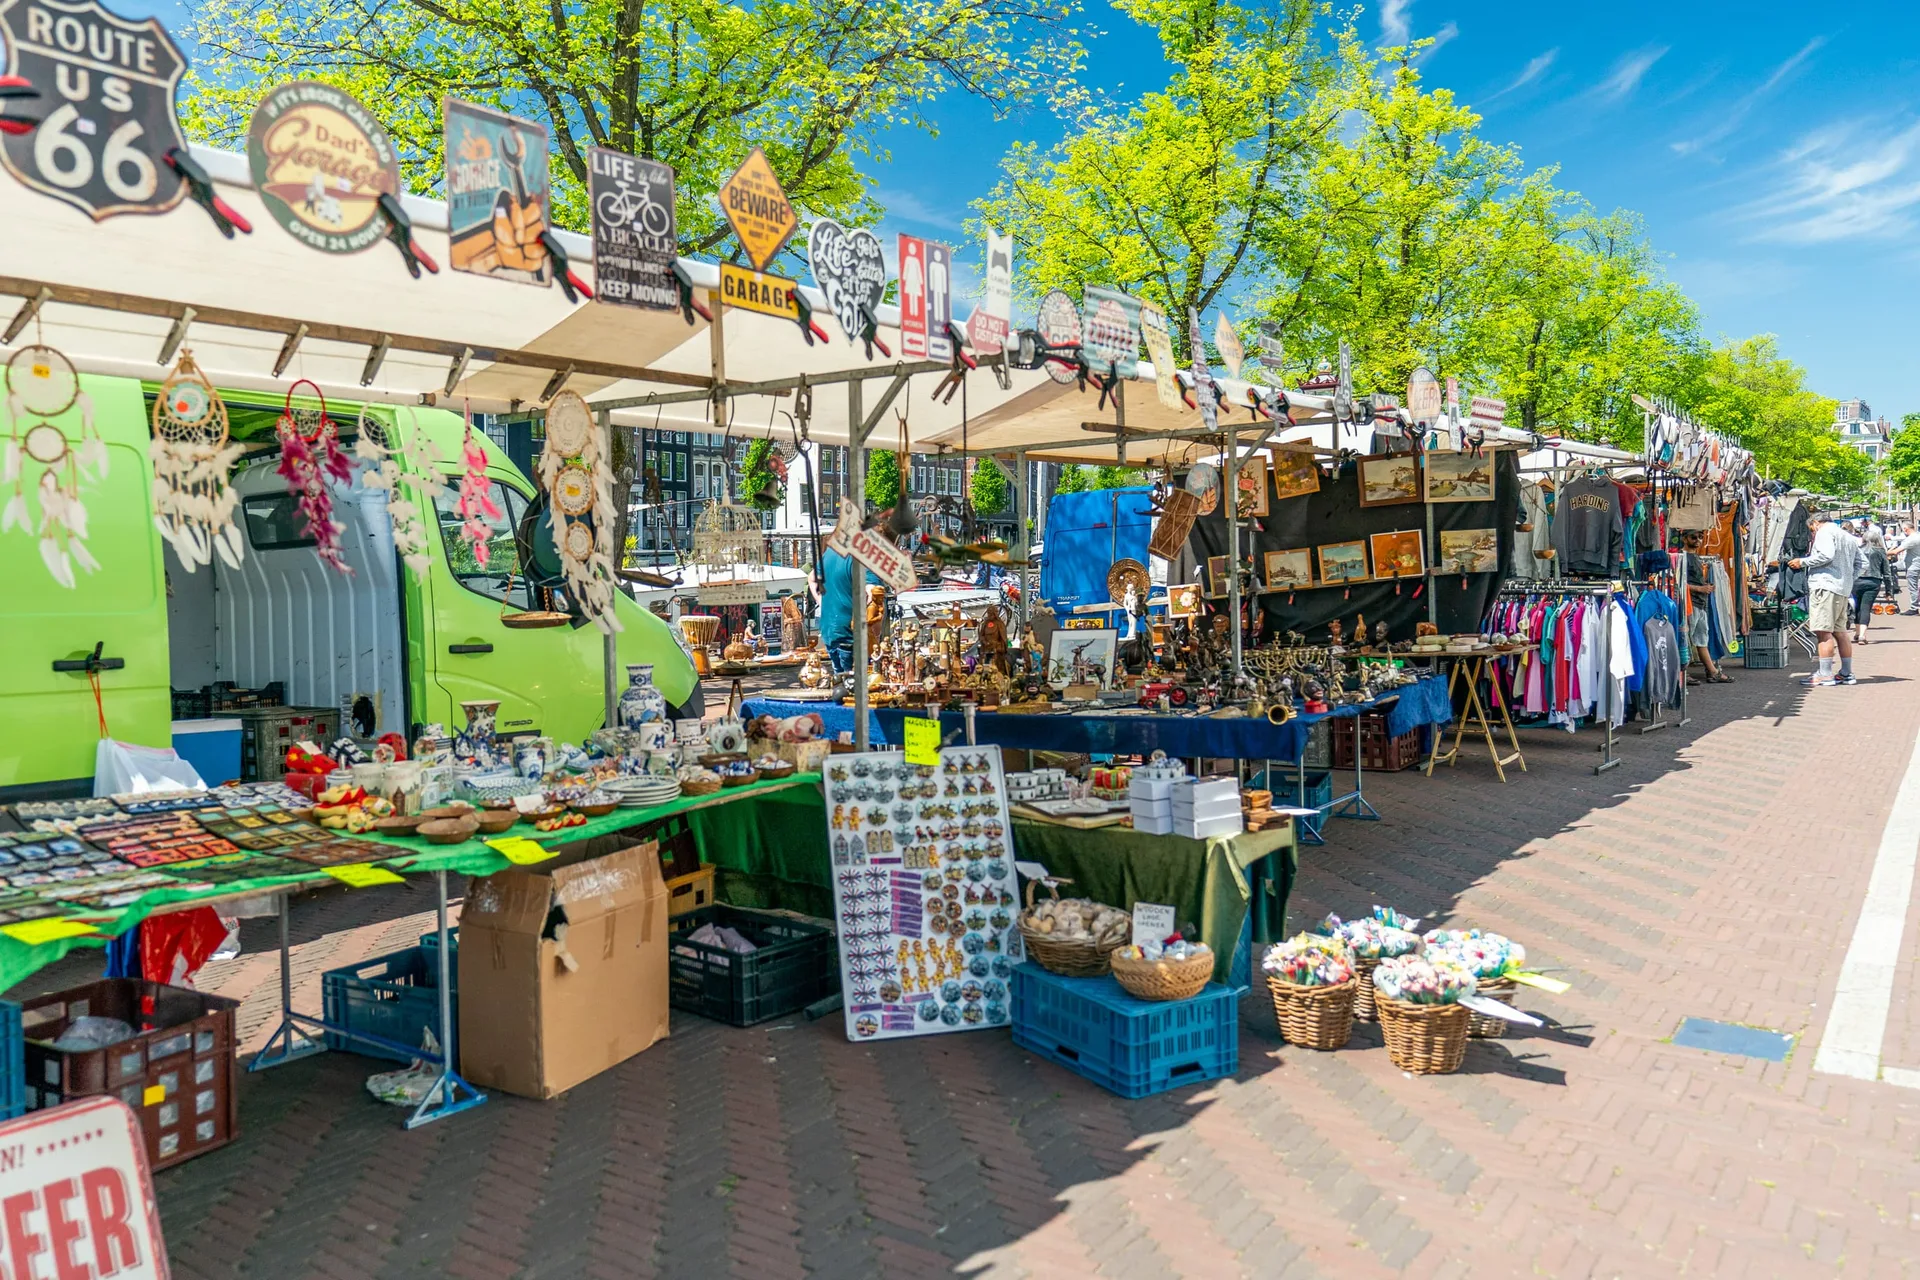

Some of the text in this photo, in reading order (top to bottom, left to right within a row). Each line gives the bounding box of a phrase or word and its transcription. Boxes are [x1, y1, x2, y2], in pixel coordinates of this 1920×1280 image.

[27, 6, 157, 74] ROUTE
[346, 103, 374, 134] CALL
[34, 103, 157, 201] 66
[315, 125, 378, 161] Dad's
[592, 151, 636, 183] LIFE
[730, 185, 786, 225] BEWARE
[289, 216, 388, 250] OPEN 24 HOURS
[597, 225, 675, 255] A BICYCLE
[814, 228, 858, 276] Life
[598, 264, 676, 289] YOU MUST
[598, 278, 677, 306] KEEP MOVING
[724, 273, 793, 310] GARAGE
[842, 274, 874, 294] after
[975, 314, 1005, 334] DO NOT
[1342, 353, 1351, 406] BAR
[1570, 494, 1609, 512] HARDING
[851, 531, 899, 578] COFFEE
[0, 1166, 142, 1280] EER
